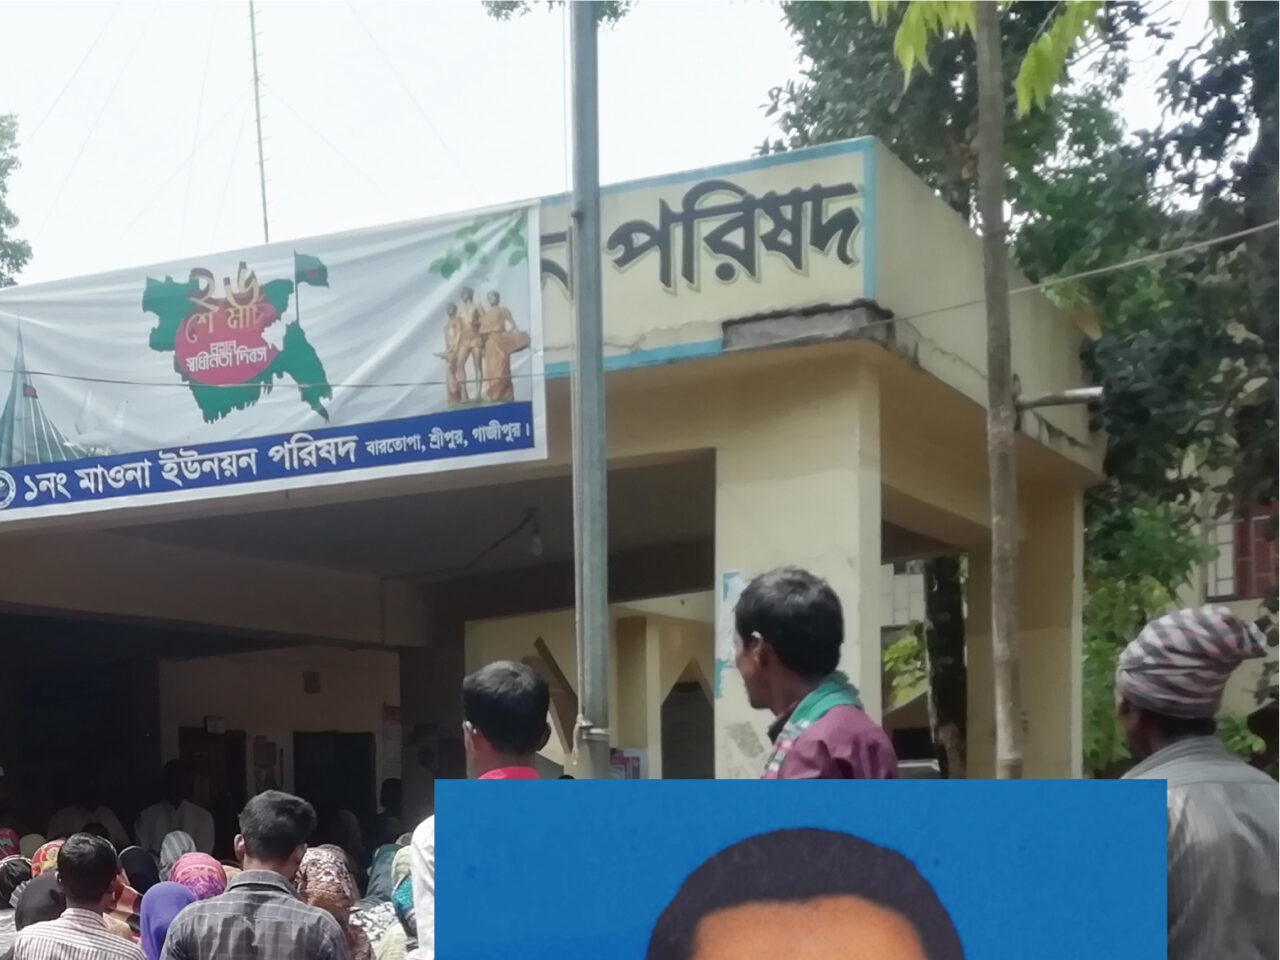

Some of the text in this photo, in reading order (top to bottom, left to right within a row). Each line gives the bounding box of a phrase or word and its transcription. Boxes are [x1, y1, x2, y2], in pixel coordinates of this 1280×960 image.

[607, 180, 860, 289] পরিষদ
[189, 261, 260, 311] ২৬
[185, 310, 215, 343] শে
[235, 345, 268, 366] দিবস
[23, 472, 71, 501] ১নং
[74, 458, 153, 494] মাওনা
[268, 432, 359, 471] পরিষদ
